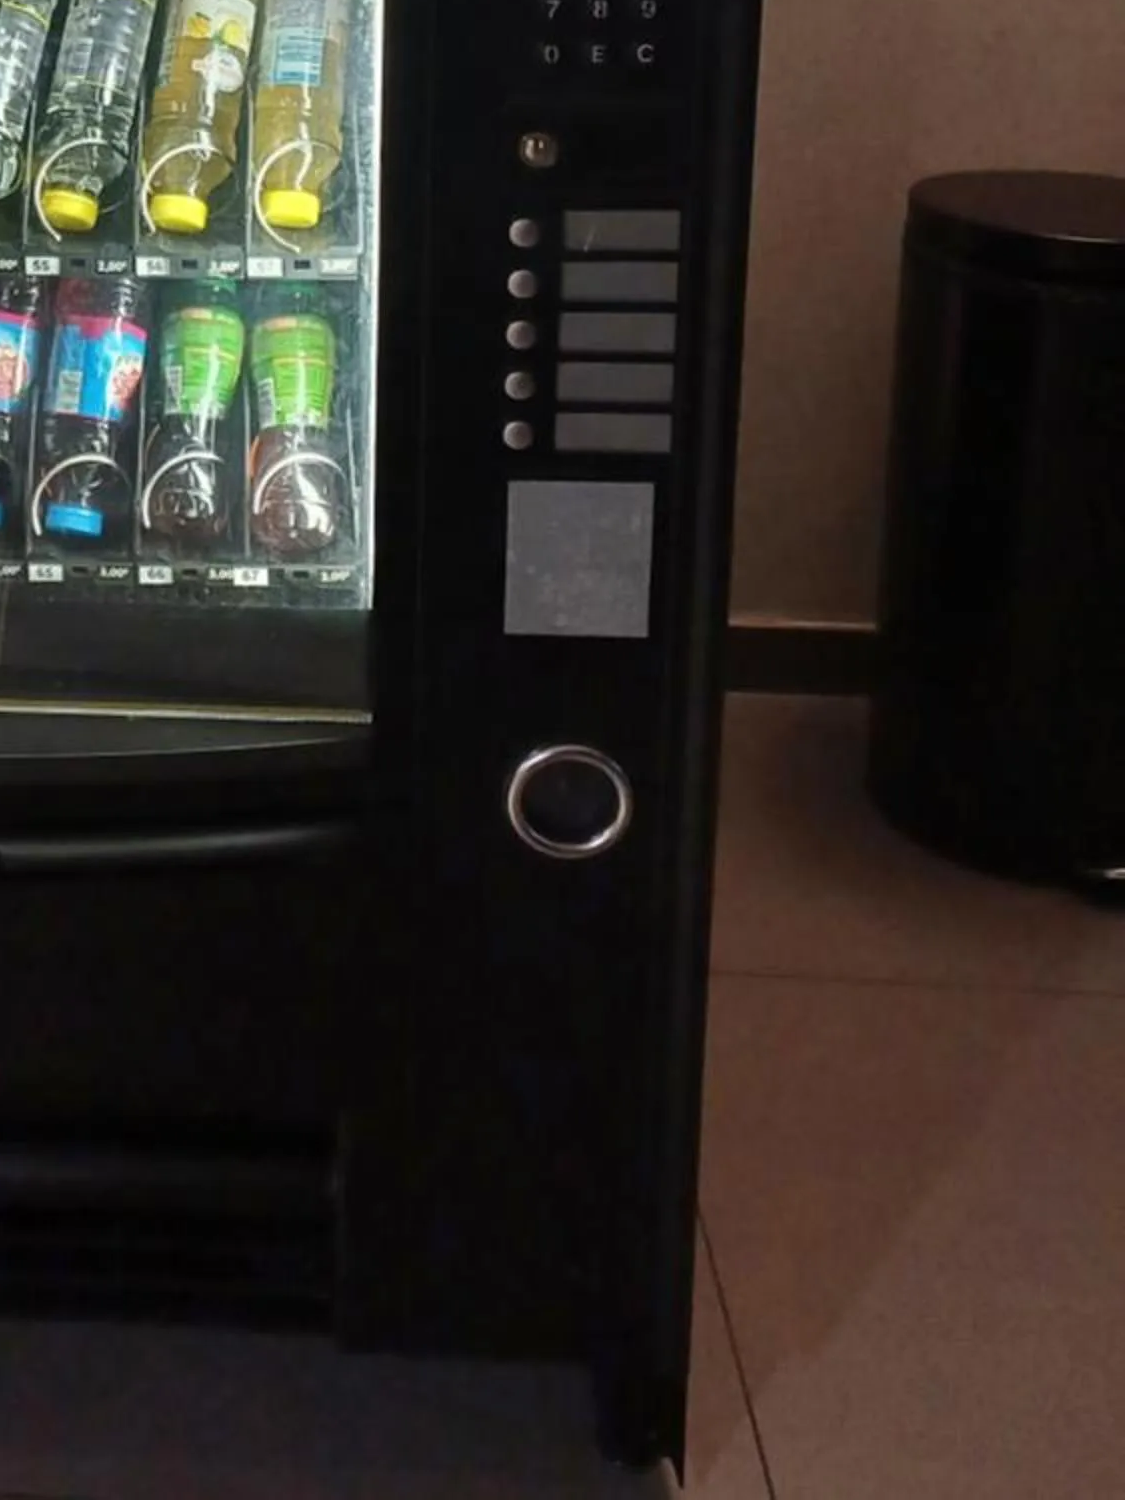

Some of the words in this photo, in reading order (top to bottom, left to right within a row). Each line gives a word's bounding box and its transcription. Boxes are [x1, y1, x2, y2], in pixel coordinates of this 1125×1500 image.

[591, 44, 606, 64] E
[636, 43, 654, 63] C
[33, 259, 50, 272] 55
